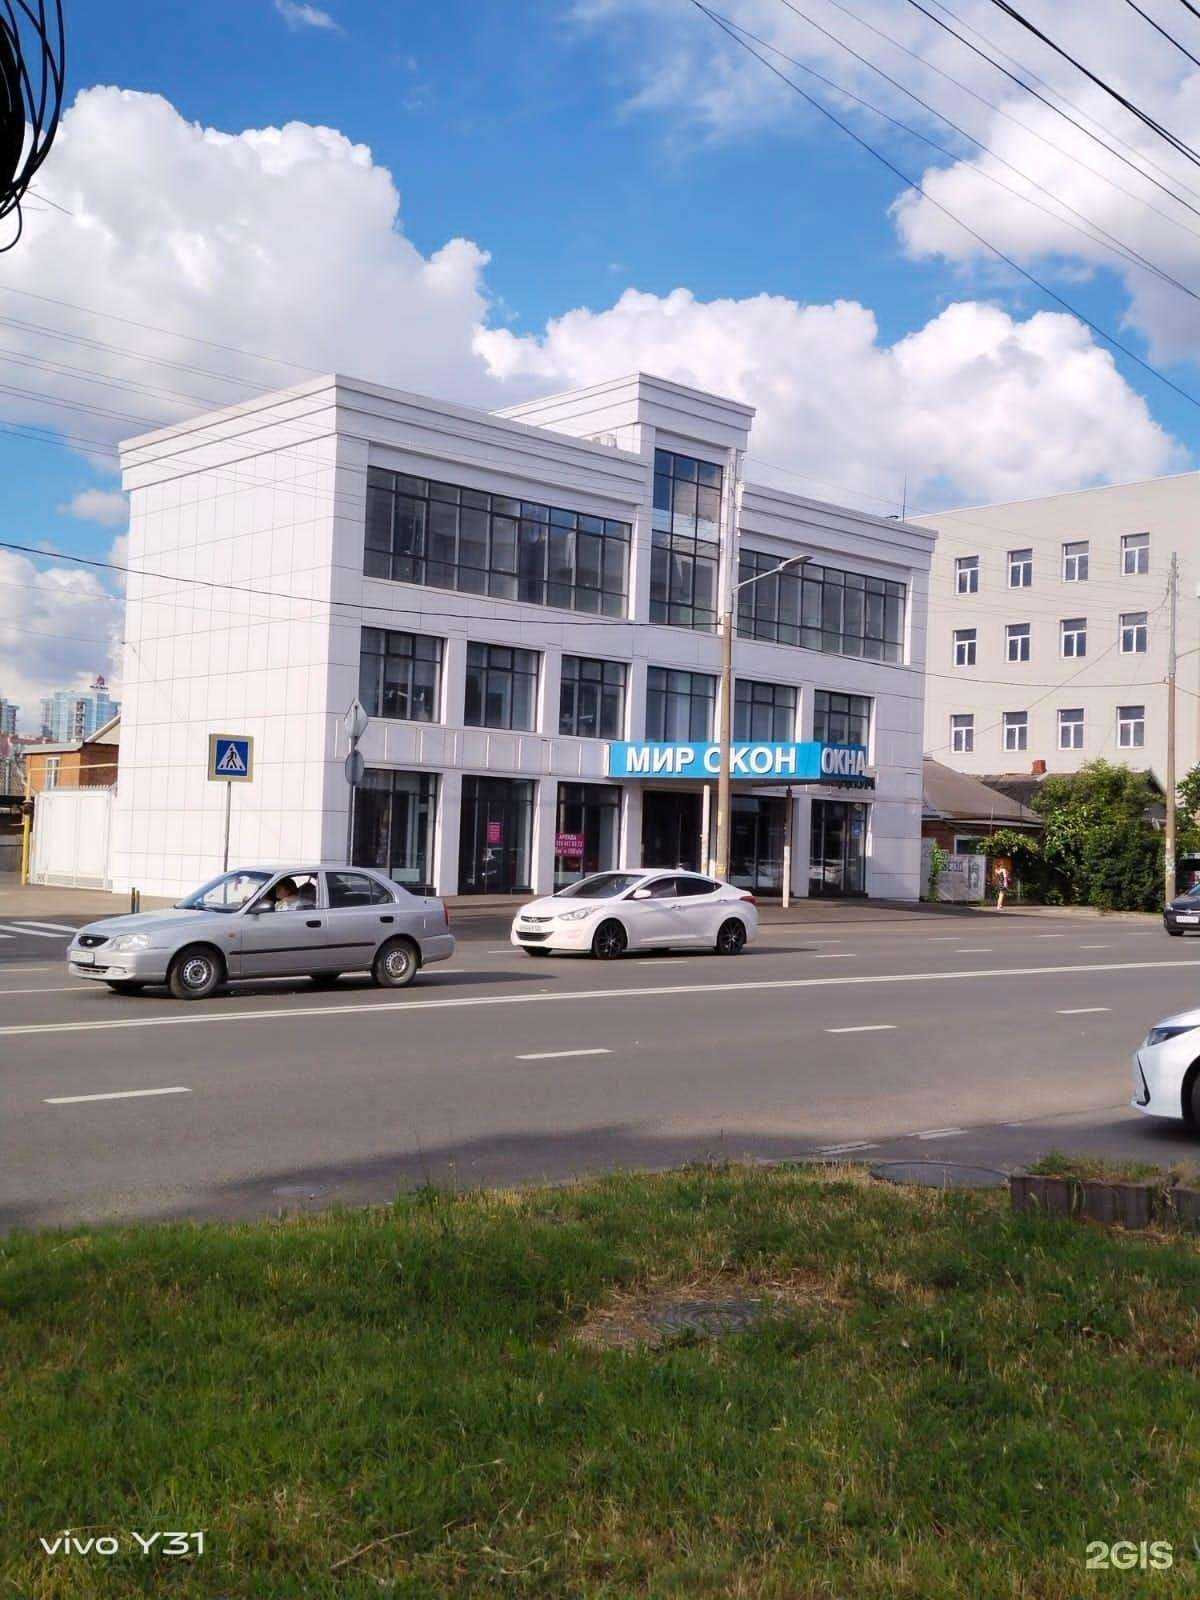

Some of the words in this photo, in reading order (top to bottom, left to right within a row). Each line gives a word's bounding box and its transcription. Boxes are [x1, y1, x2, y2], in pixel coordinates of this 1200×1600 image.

[626, 747, 694, 773] МИР
[703, 747, 797, 774] ОКОН
[821, 747, 865, 776] ОКНА
